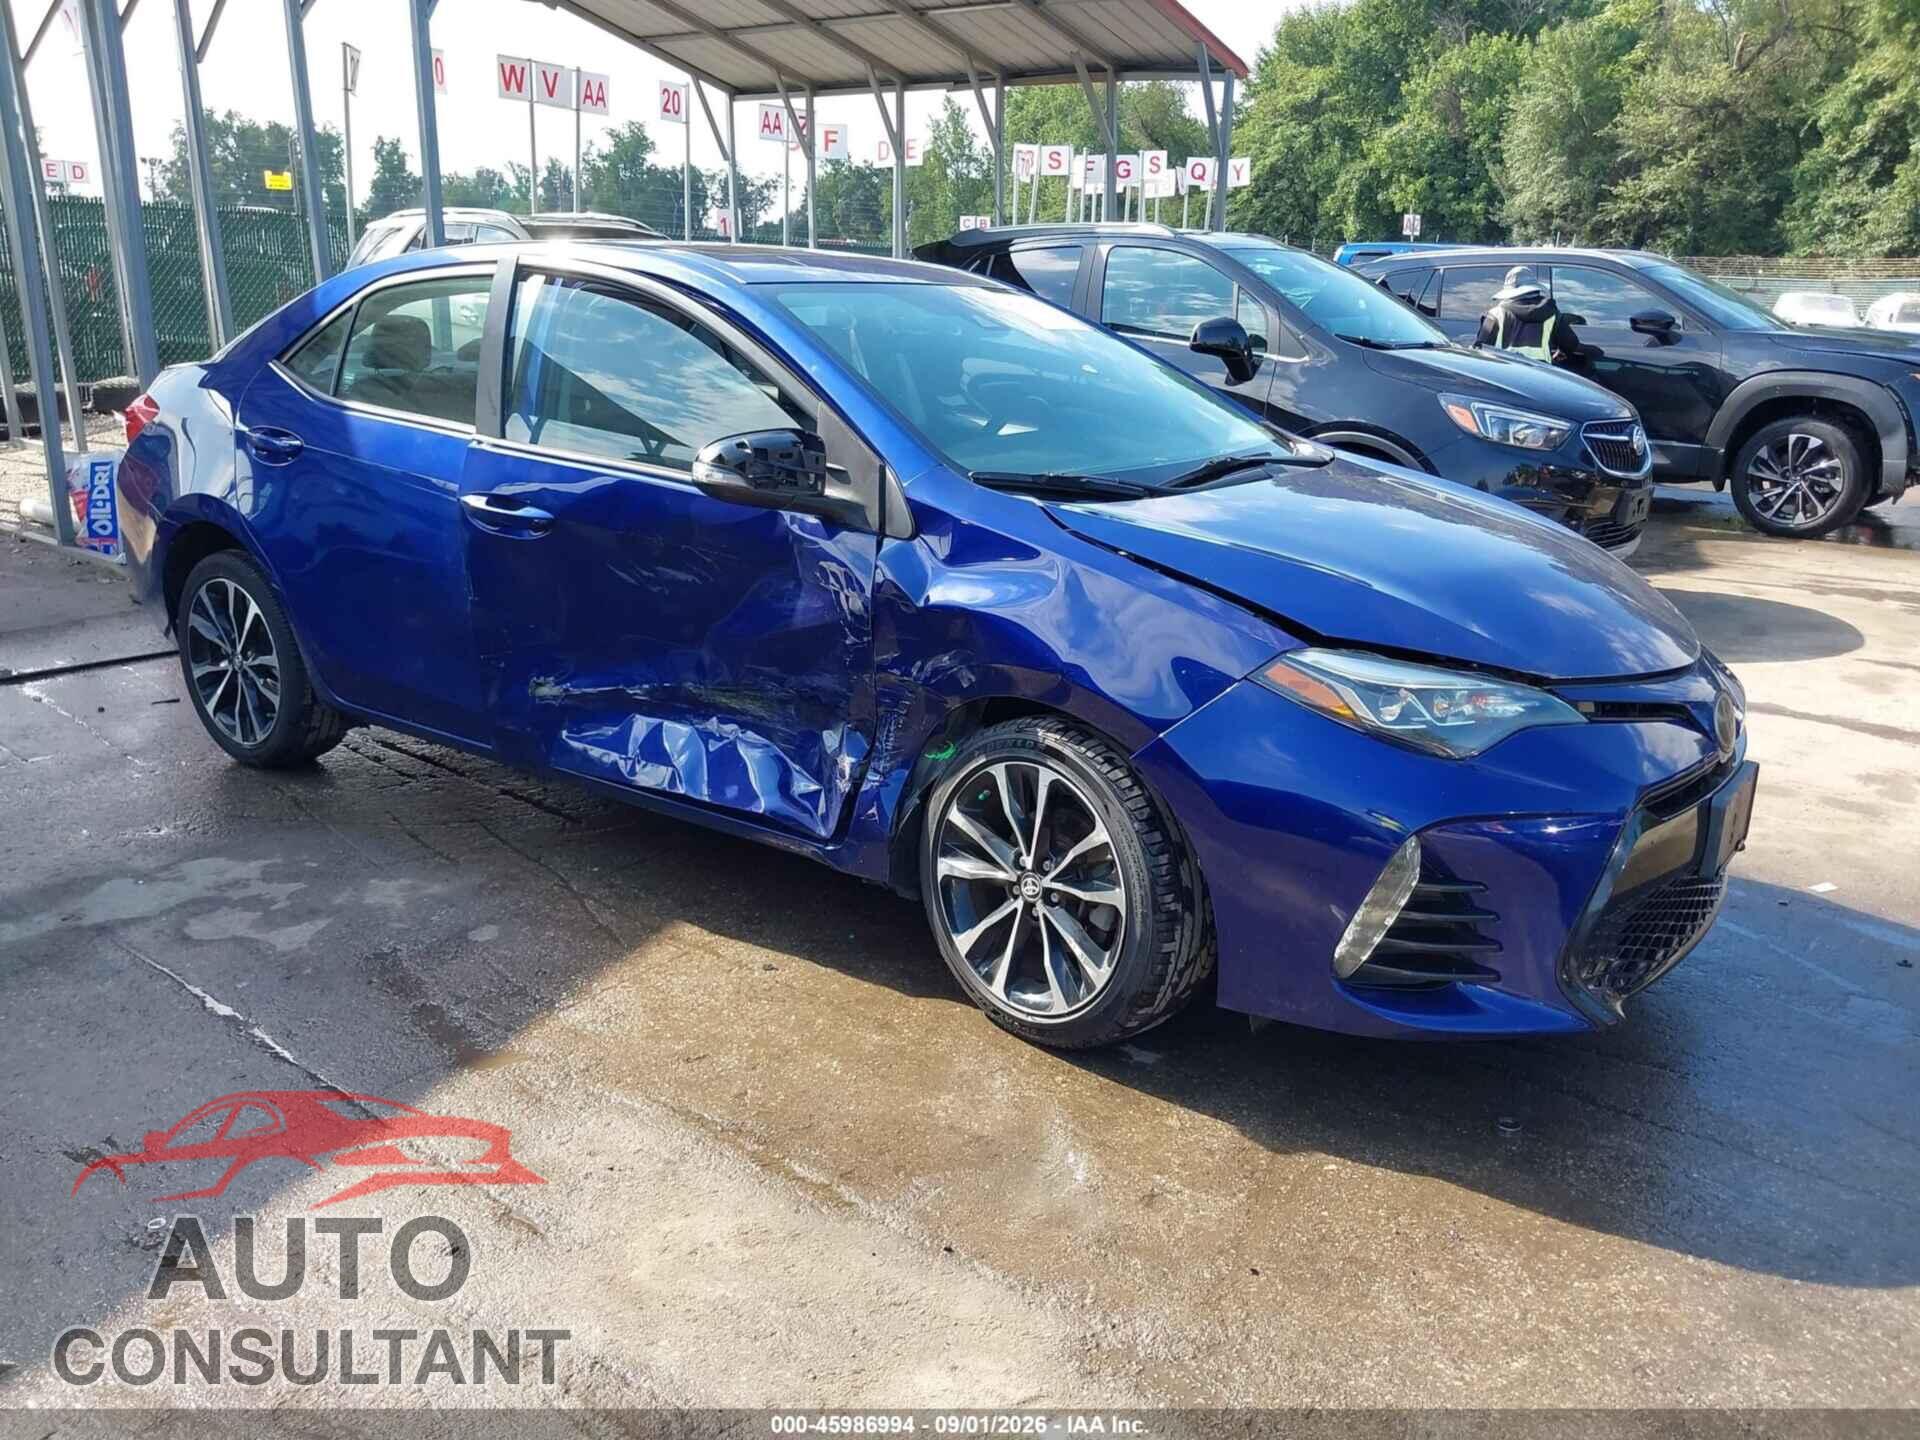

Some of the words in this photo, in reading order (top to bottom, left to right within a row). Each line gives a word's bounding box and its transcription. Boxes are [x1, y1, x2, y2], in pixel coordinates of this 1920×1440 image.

[500, 62, 526, 93] W
[541, 69, 558, 98] V
[583, 80, 606, 108] AA
[662, 88, 680, 115] 20
[761, 111, 782, 134] AA
[824, 130, 838, 152] F
[878, 141, 890, 160] D
[906, 139, 917, 159] E
[46, 163, 57, 177] E
[1048, 151, 1062, 169] S
[1115, 160, 1131, 179] G
[1149, 156, 1161, 174] S
[72, 164, 84, 179] D
[1191, 162, 1206, 182] Q
[1232, 163, 1244, 181] Y
